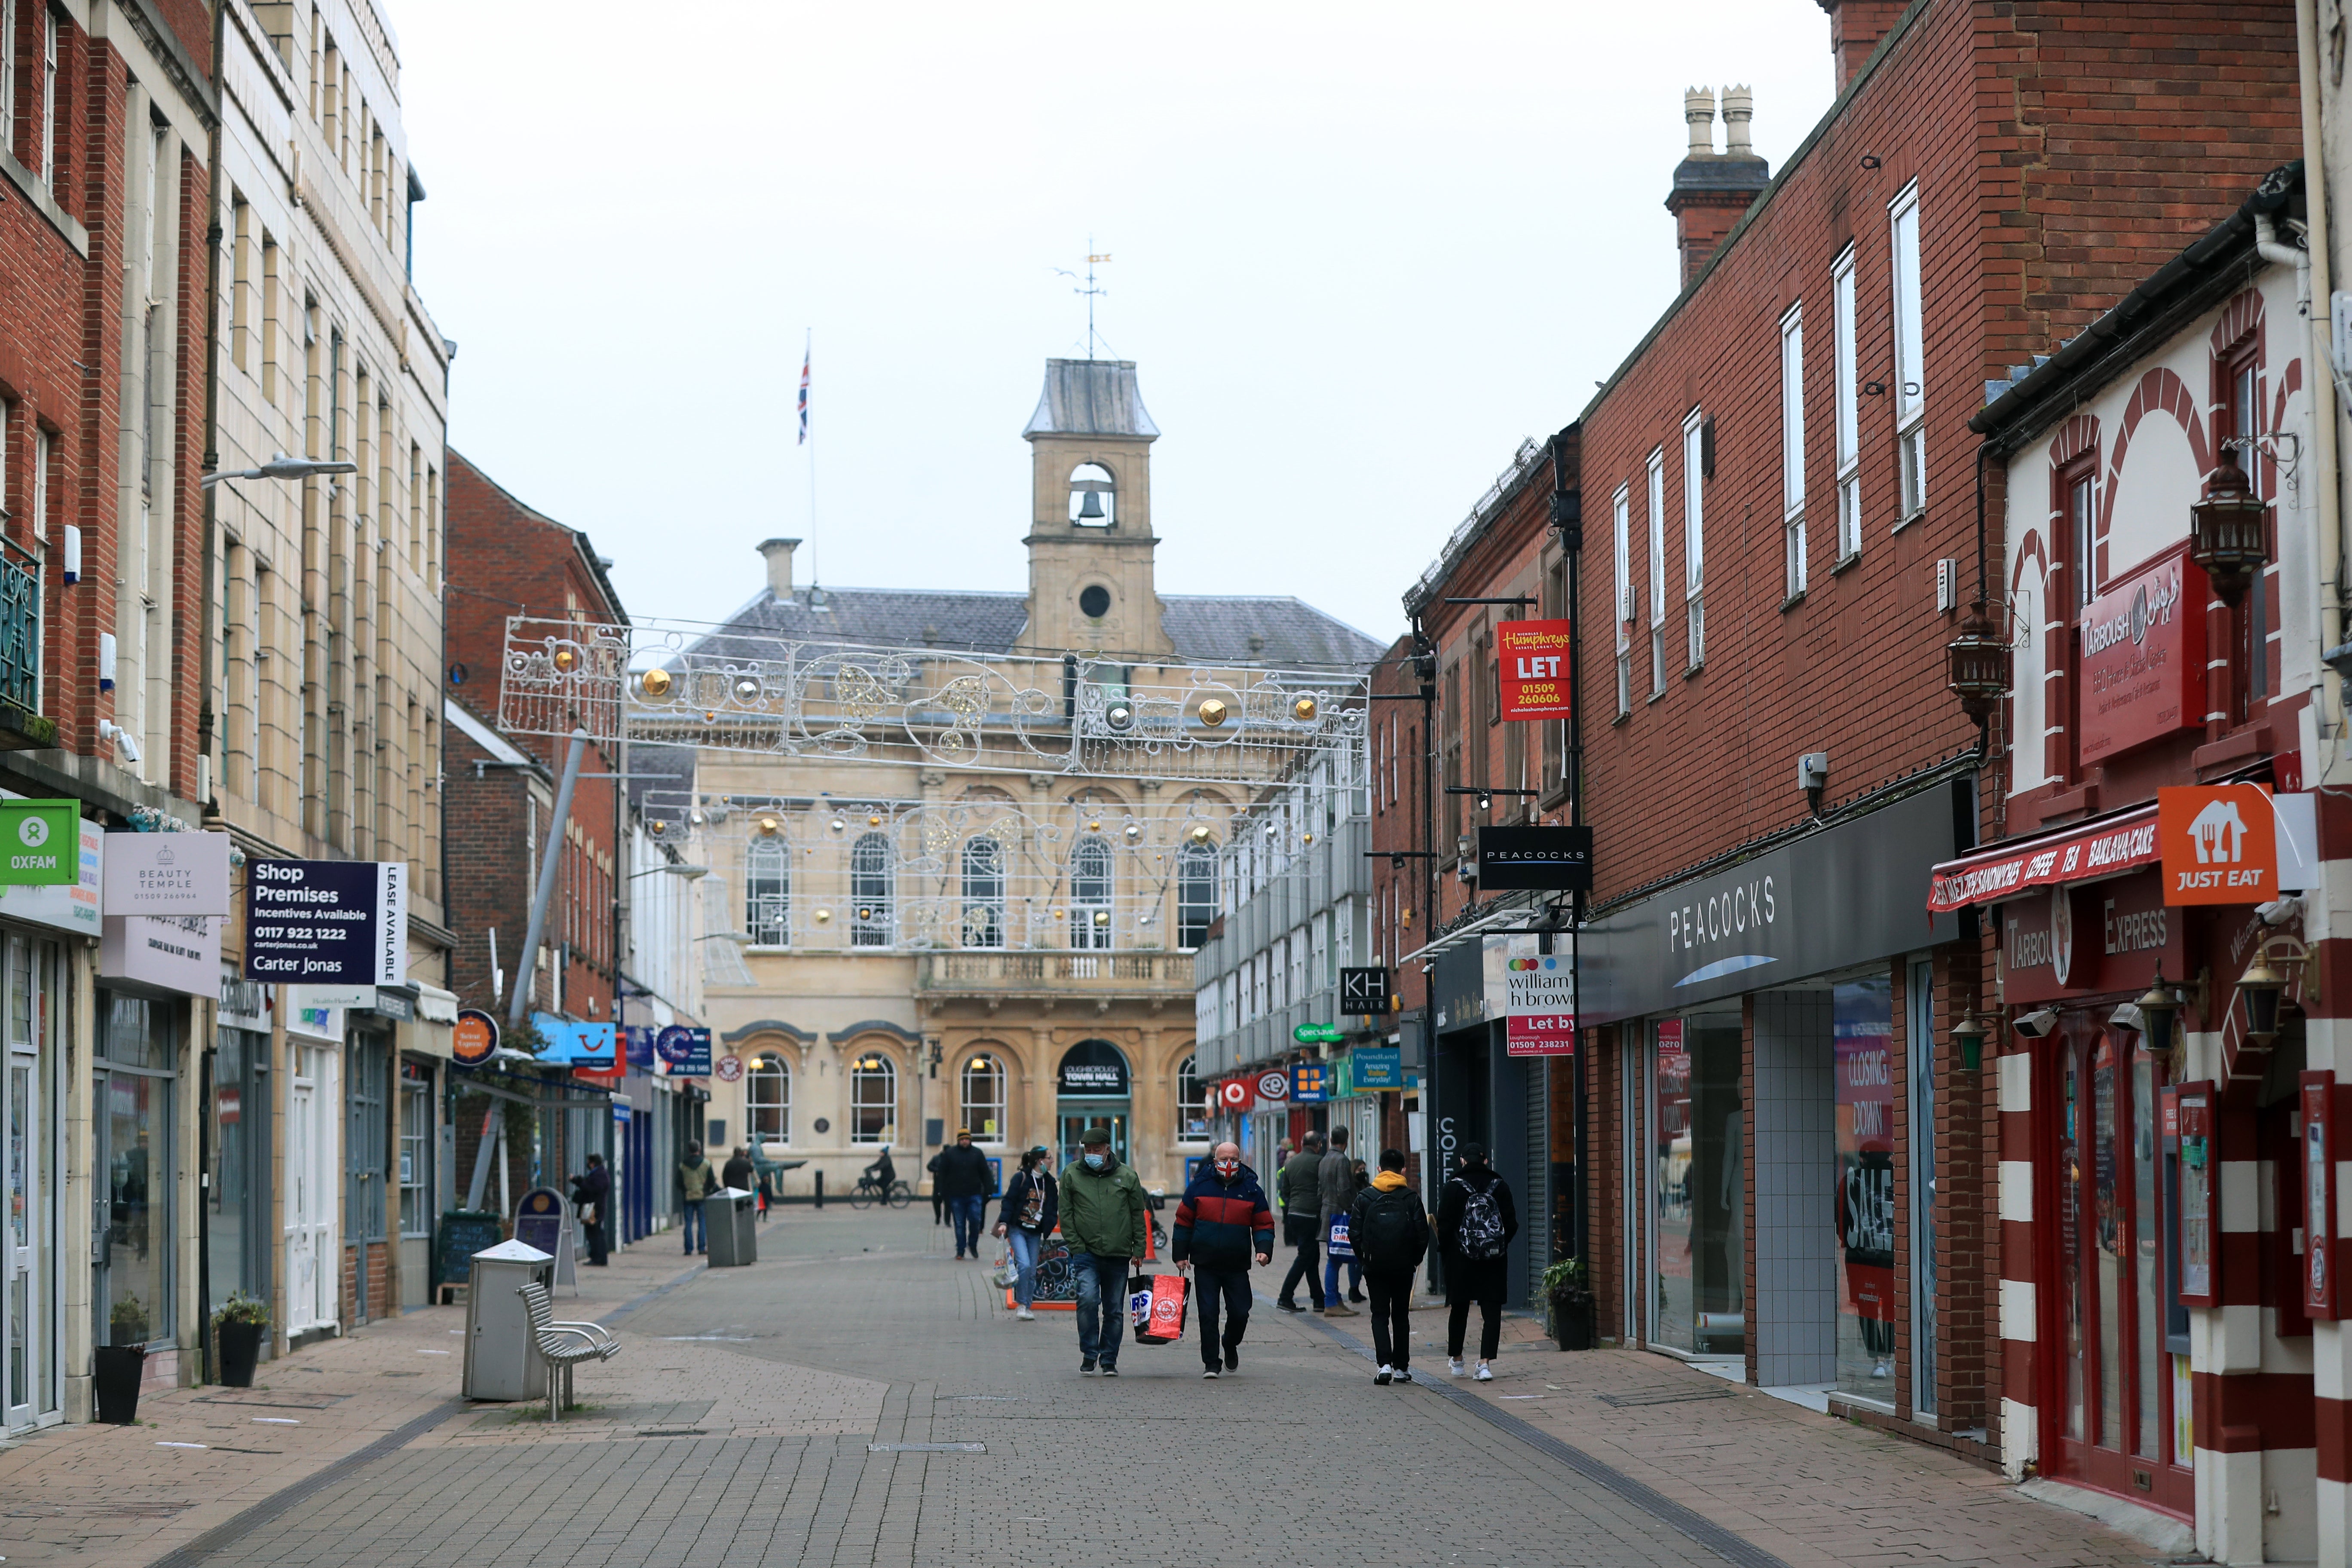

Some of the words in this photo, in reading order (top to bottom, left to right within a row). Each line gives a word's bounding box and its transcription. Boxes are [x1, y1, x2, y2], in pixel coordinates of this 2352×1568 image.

[1502, 631, 1569, 651] Humphreys
[2082, 612, 2131, 658] TARBOUSH
[1517, 656, 1561, 679] LET
[1522, 683, 1555, 694] 01509
[1518, 694, 1560, 704] 260606
[2061, 845, 2081, 873] TEA
[2087, 824, 2156, 868] BAKLAVA/CAKE
[11, 856, 57, 869] OXFAM
[256, 864, 304, 883] Shop
[2177, 871, 2224, 891] JUST
[2227, 870, 2263, 886] EAT
[255, 885, 339, 903] Premises
[387, 867, 397, 906] LEASE
[254, 907, 312, 919] Incentives
[314, 909, 367, 921] Available
[1670, 875, 1775, 953] PEACOCKS
[254, 926, 284, 938] 0117
[287, 928, 313, 939] 922
[315, 928, 347, 940] 1222
[2008, 918, 2052, 969] TARBOU
[2104, 897, 2166, 955] EXPRESS
[254, 941, 318, 950] carterjonas.co.uk
[385, 910, 395, 980] AVAILABLE
[254, 956, 300, 971] Carter
[301, 957, 342, 974] Jonas
[1346, 972, 1383, 997] KH
[1509, 974, 1568, 989] william
[1346, 1001, 1384, 1010] HAIR
[1511, 992, 1521, 1006] h
[1528, 1018, 1553, 1030] Let
[1559, 1016, 1574, 1032] by
[1065, 1073, 1094, 1081] TOWN
[1095, 1073, 1119, 1081] HALL
[1849, 1050, 1887, 1087] CLOSING
[1853, 1101, 1883, 1135] DOWN
[1847, 1167, 1892, 1251] SALE
